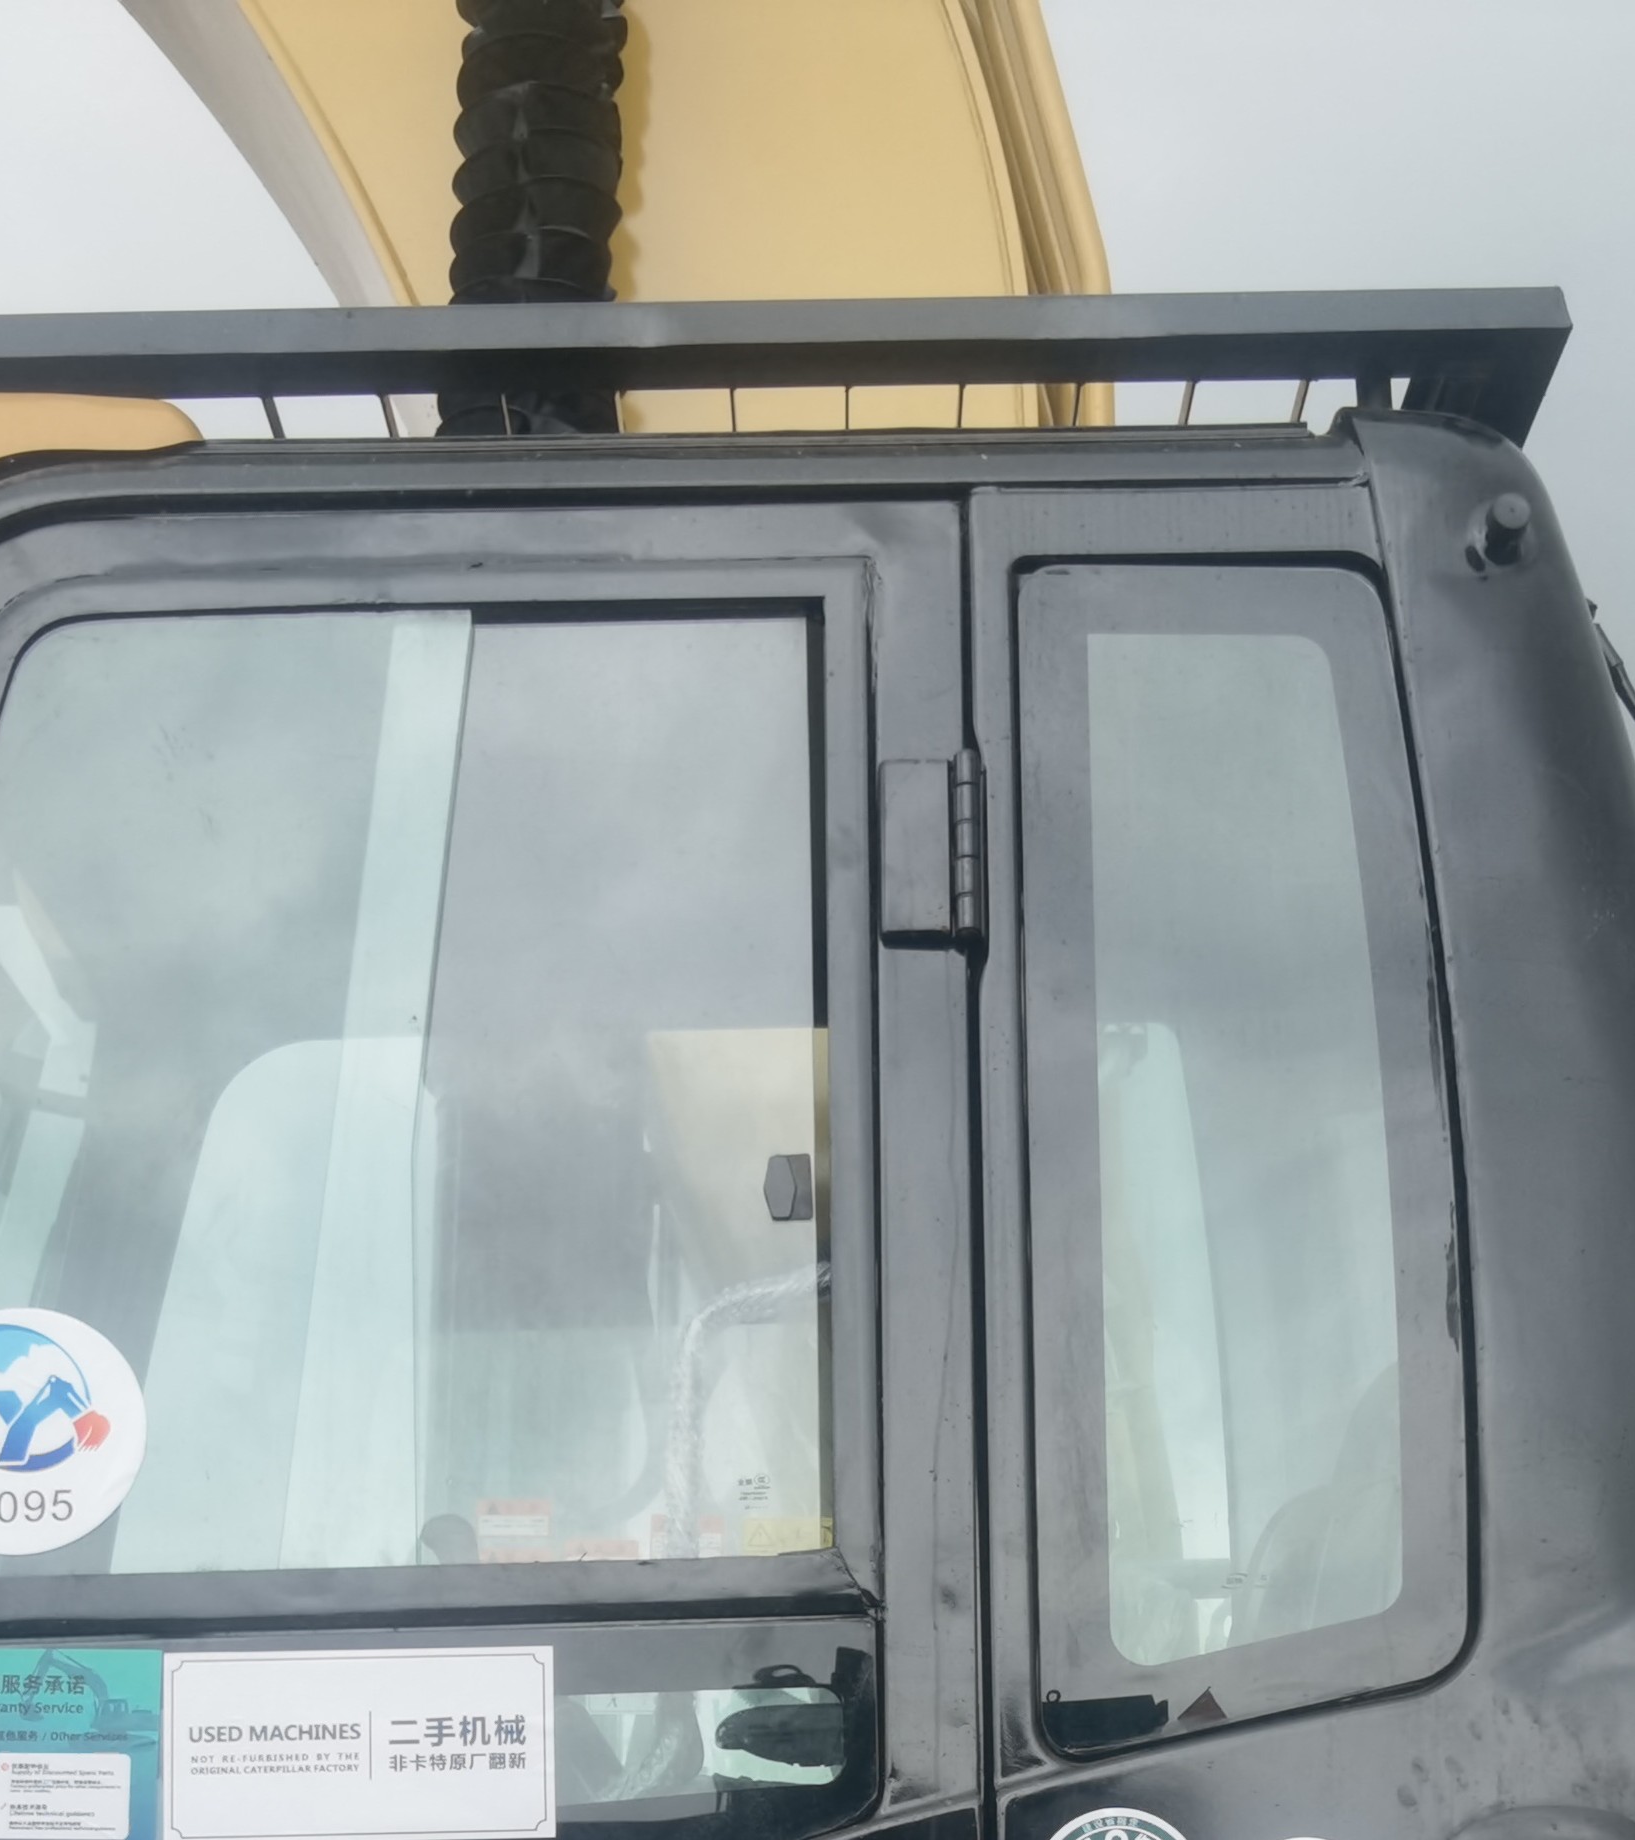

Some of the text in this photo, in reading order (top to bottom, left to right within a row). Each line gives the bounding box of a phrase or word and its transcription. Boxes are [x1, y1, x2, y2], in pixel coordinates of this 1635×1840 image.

[34, 1702, 84, 1714] Service
[50, 1731, 82, 1741] Other
[189, 1723, 362, 1743] USED MACHINES
[388, 1714, 527, 1748] 二手机械
[191, 1754, 214, 1764] NOT
[316, 1753, 330, 1762] BY
[337, 1752, 360, 1761] THE
[388, 1751, 527, 1773] 非卡特原厂翻新
[190, 1763, 360, 1775] ORIGINAL CATERPILLAR FACTORY
